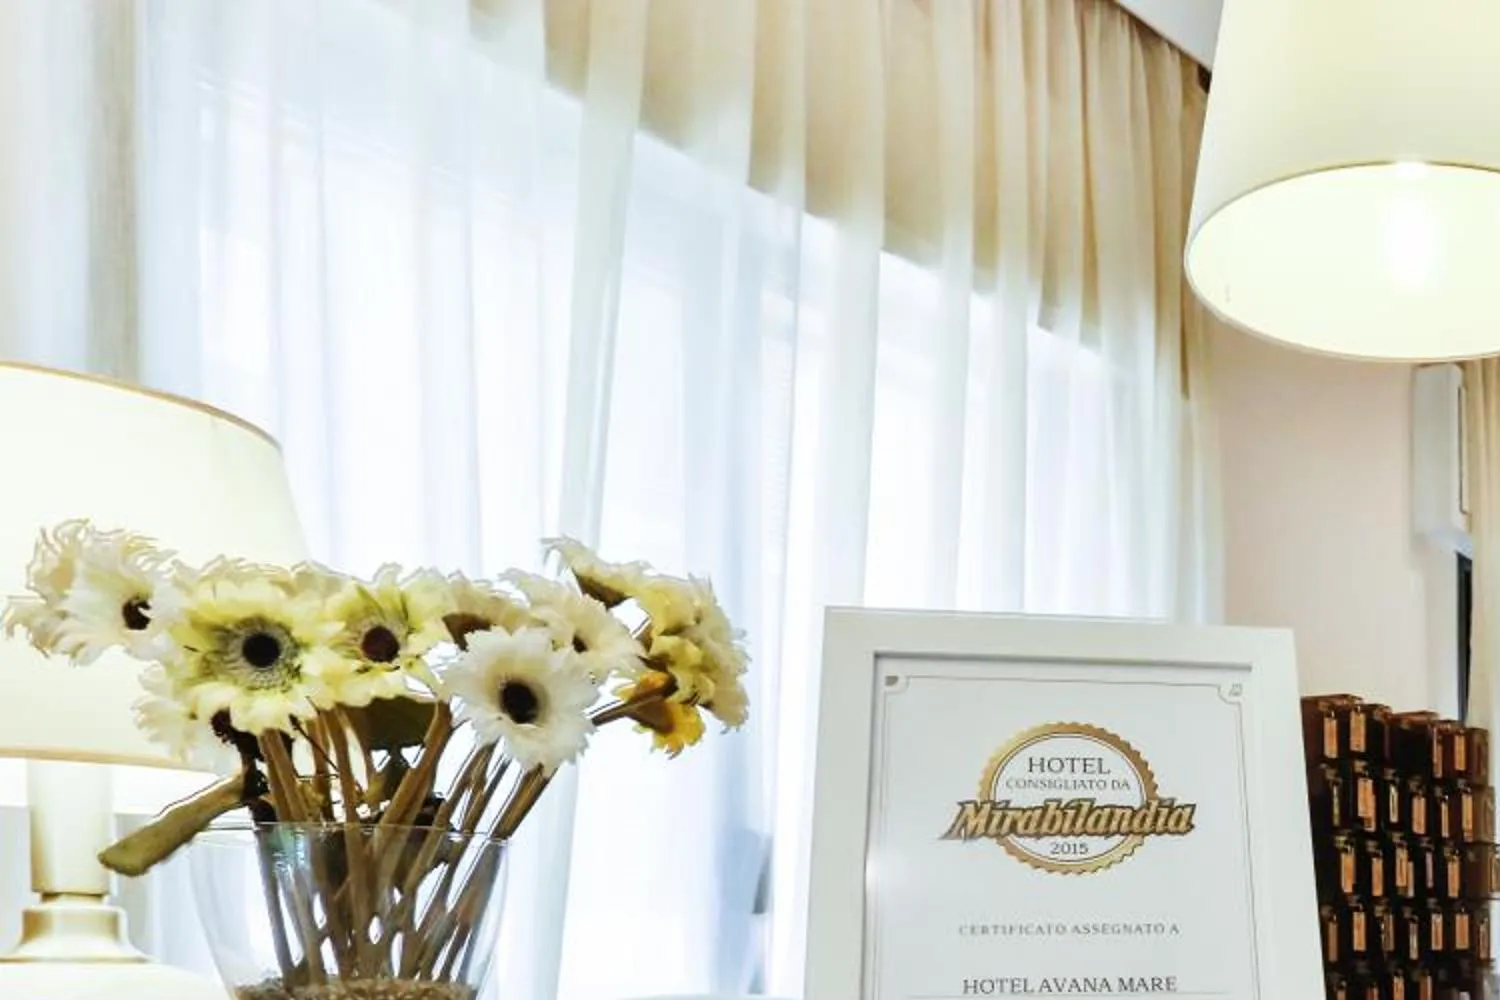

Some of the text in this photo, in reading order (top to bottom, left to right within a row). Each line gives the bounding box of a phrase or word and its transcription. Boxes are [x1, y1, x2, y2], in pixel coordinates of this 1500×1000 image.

[1027, 756, 1111, 775] HOTEL
[1005, 778, 1131, 792] CONSIGLIATO DA
[939, 797, 1197, 843] Mirabilandia
[1050, 842, 1089, 855] 2015
[959, 922, 1180, 936] CERTIFICATO ASSEGNATO A
[962, 975, 1177, 995] HOTEL AVANA MARE
